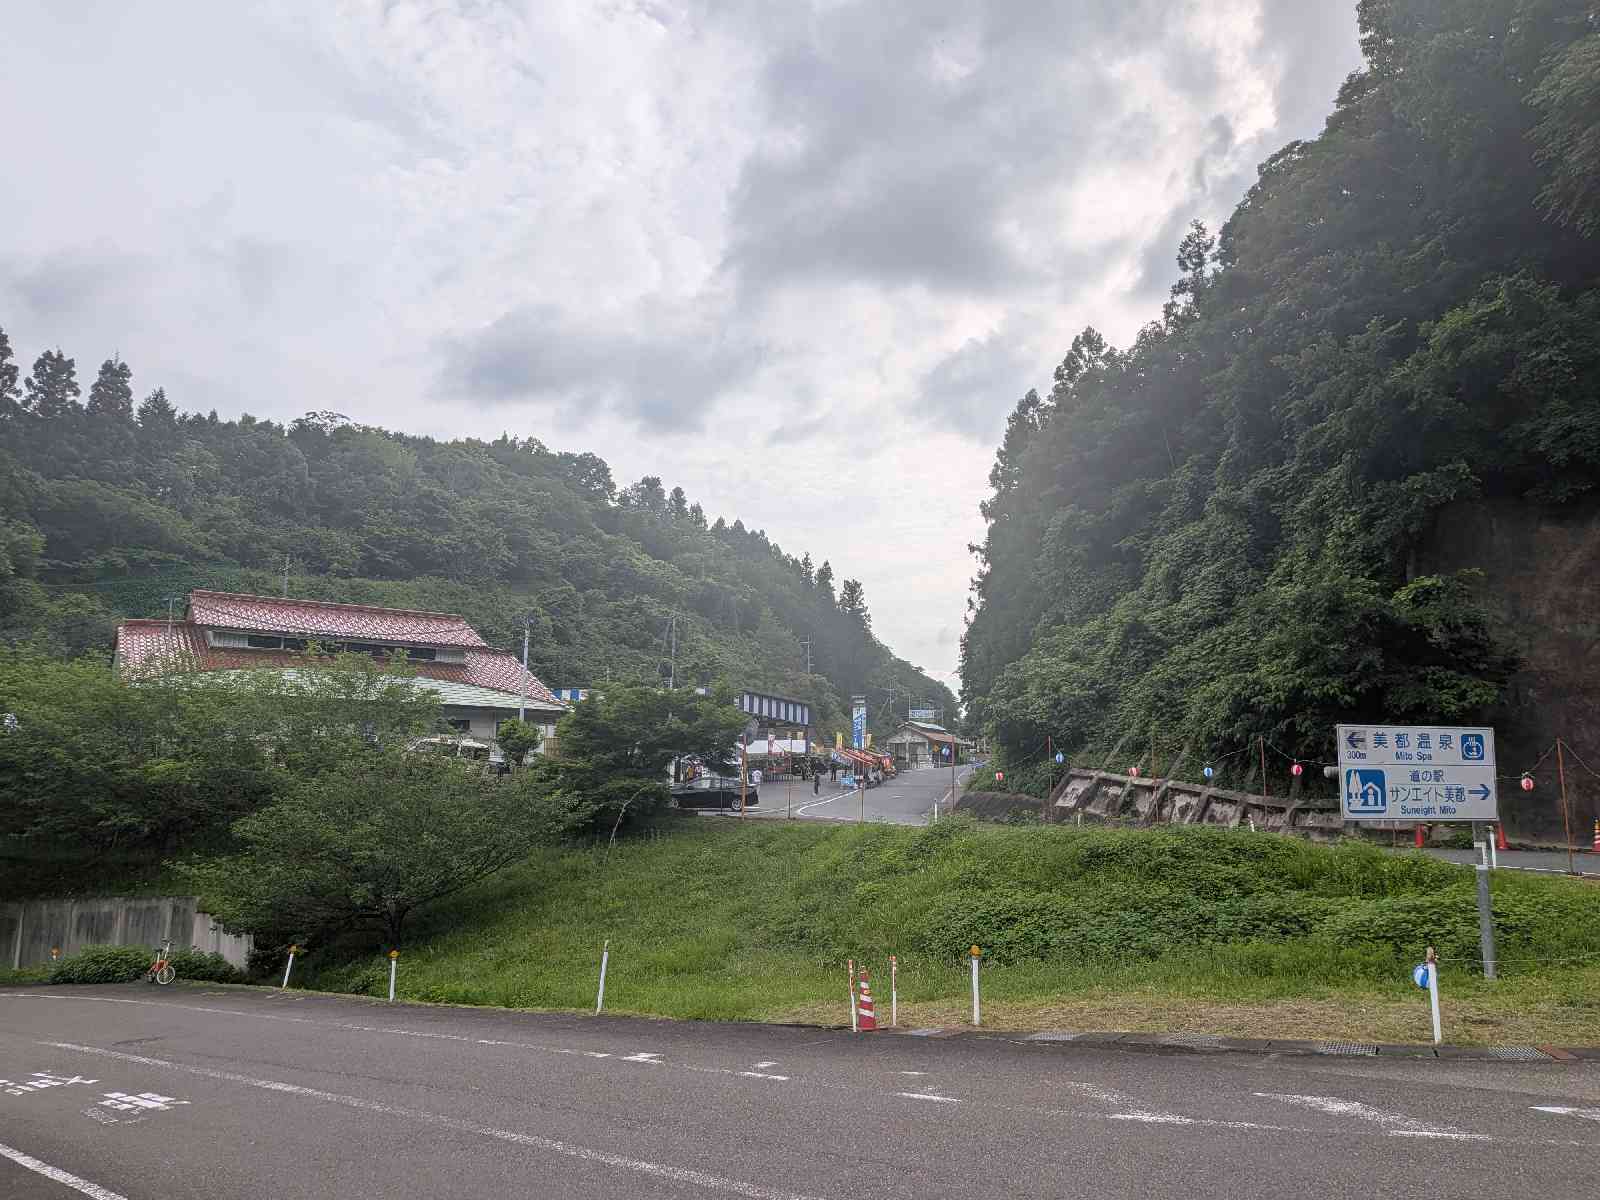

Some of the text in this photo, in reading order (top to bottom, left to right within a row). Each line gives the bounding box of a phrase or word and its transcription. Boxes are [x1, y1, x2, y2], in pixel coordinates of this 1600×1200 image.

[1373, 732, 1453, 751] 美都温泉
[1395, 751, 1432, 762] Mito Spa
[1409, 769, 1444, 783] 道の駅
[1389, 786, 1466, 803] サンエイト美都
[1400, 805, 1457, 816] Suneight Mito
